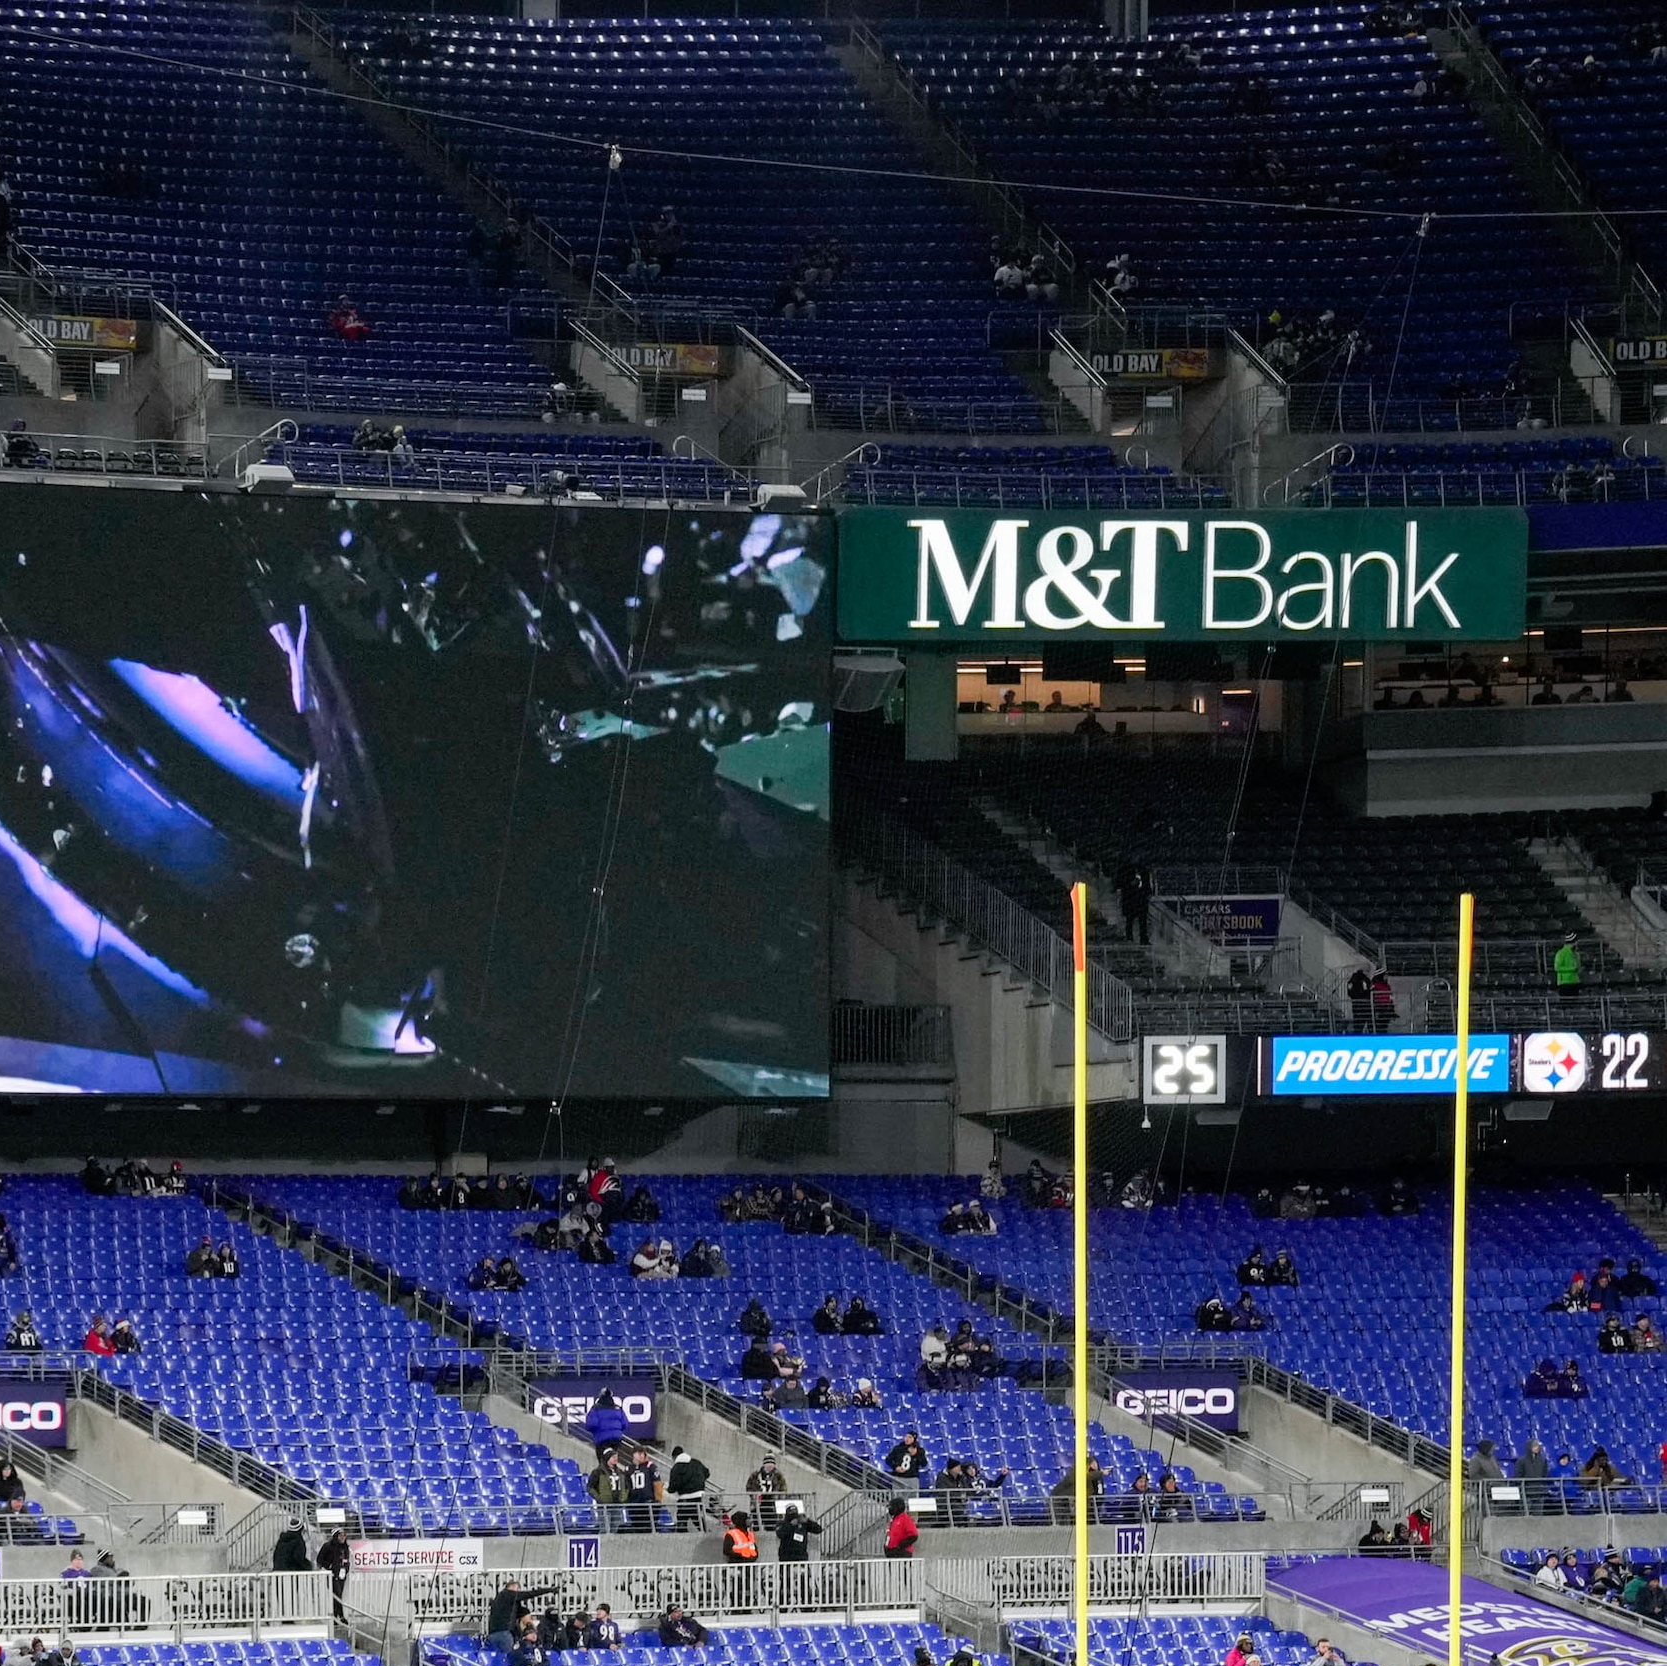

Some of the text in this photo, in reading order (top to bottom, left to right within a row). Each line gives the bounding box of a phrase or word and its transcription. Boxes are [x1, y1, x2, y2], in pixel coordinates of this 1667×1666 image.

[62, 319, 91, 340] BAY
[1616, 341, 1651, 361] OLD
[1095, 354, 1160, 374] OLD BAY
[907, 520, 1463, 631] M&T Bank
[1153, 1044, 1216, 1094] 25
[1275, 1047, 1499, 1082] PROGRESSIVE
[1601, 1034, 1649, 1089] 22
[1116, 1388, 1235, 1415] GEICO
[903, 1455, 912, 1471] 8
[1118, 1531, 1143, 1554] 115
[354, 1550, 479, 1567] SEATS SERVICE CSX
[570, 1542, 597, 1568] 114
[600, 1621, 616, 1641] 98
